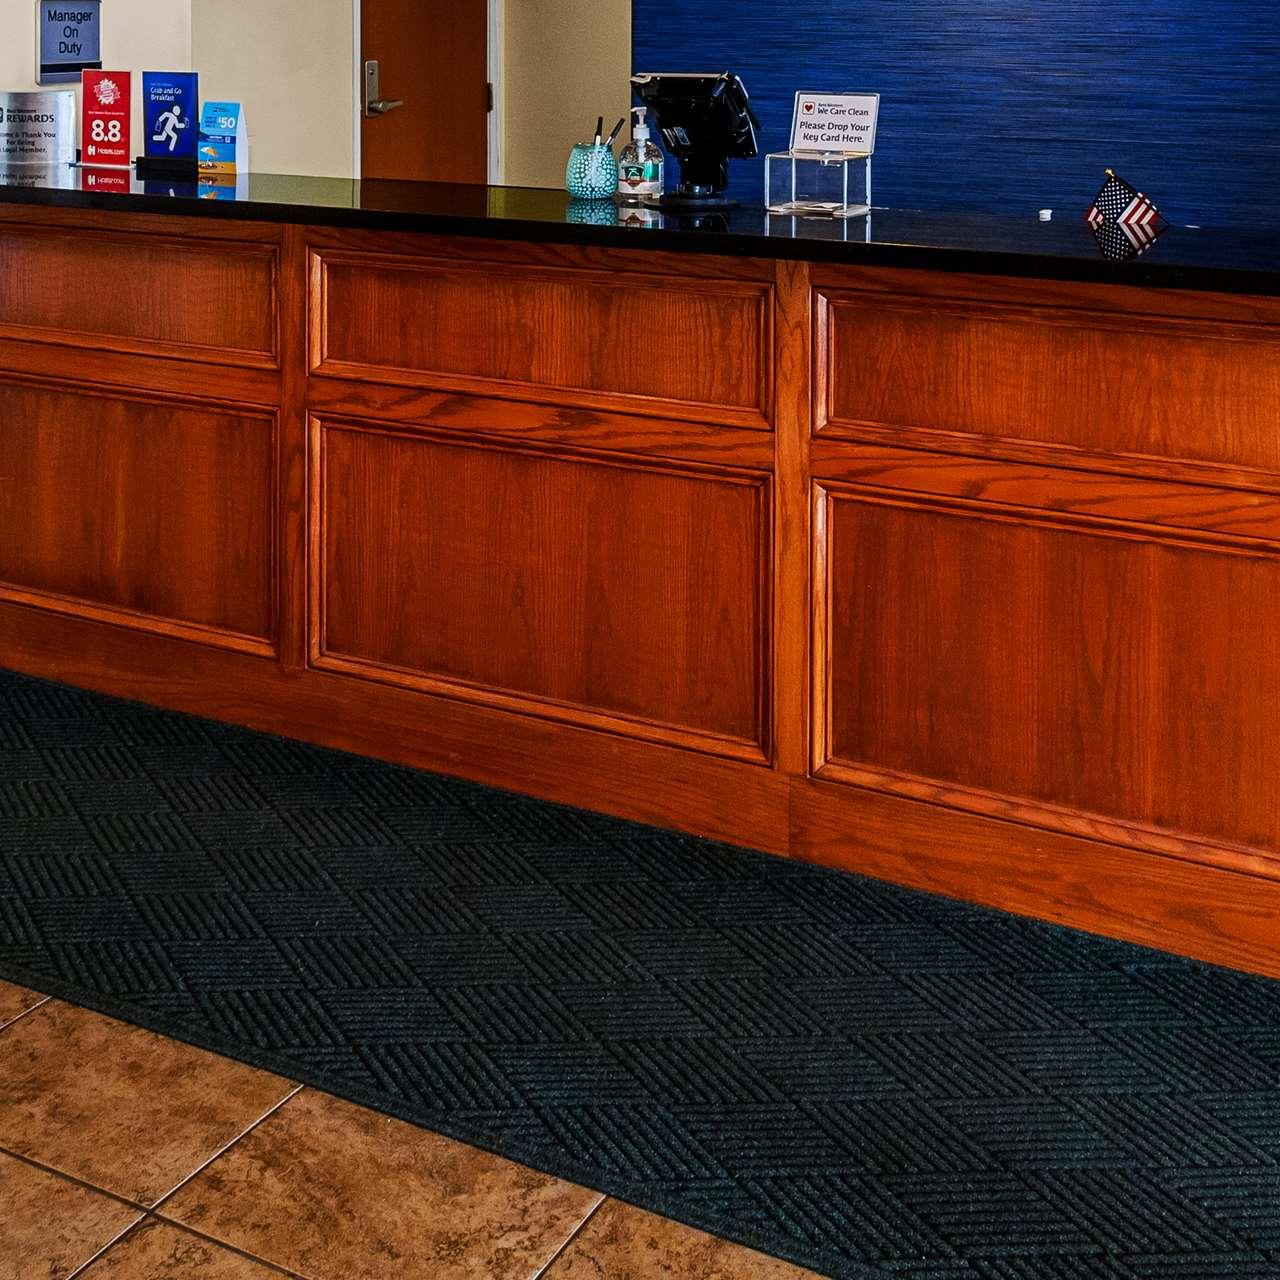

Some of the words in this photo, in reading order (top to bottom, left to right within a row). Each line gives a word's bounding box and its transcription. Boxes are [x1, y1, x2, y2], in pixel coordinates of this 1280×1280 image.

[48, 10, 93, 24] Manager
[63, 26, 79, 38] On
[59, 42, 82, 56] Duty
[848, 108, 869, 116] Clean
[6, 114, 55, 123] REWARDS
[91, 119, 121, 142] 8.8
[800, 121, 825, 130] Please
[828, 122, 848, 131] Drop
[850, 123, 870, 131] Your
[803, 133, 818, 142] Key
[820, 133, 840, 142] Card
[842, 135, 864, 143] Here.
